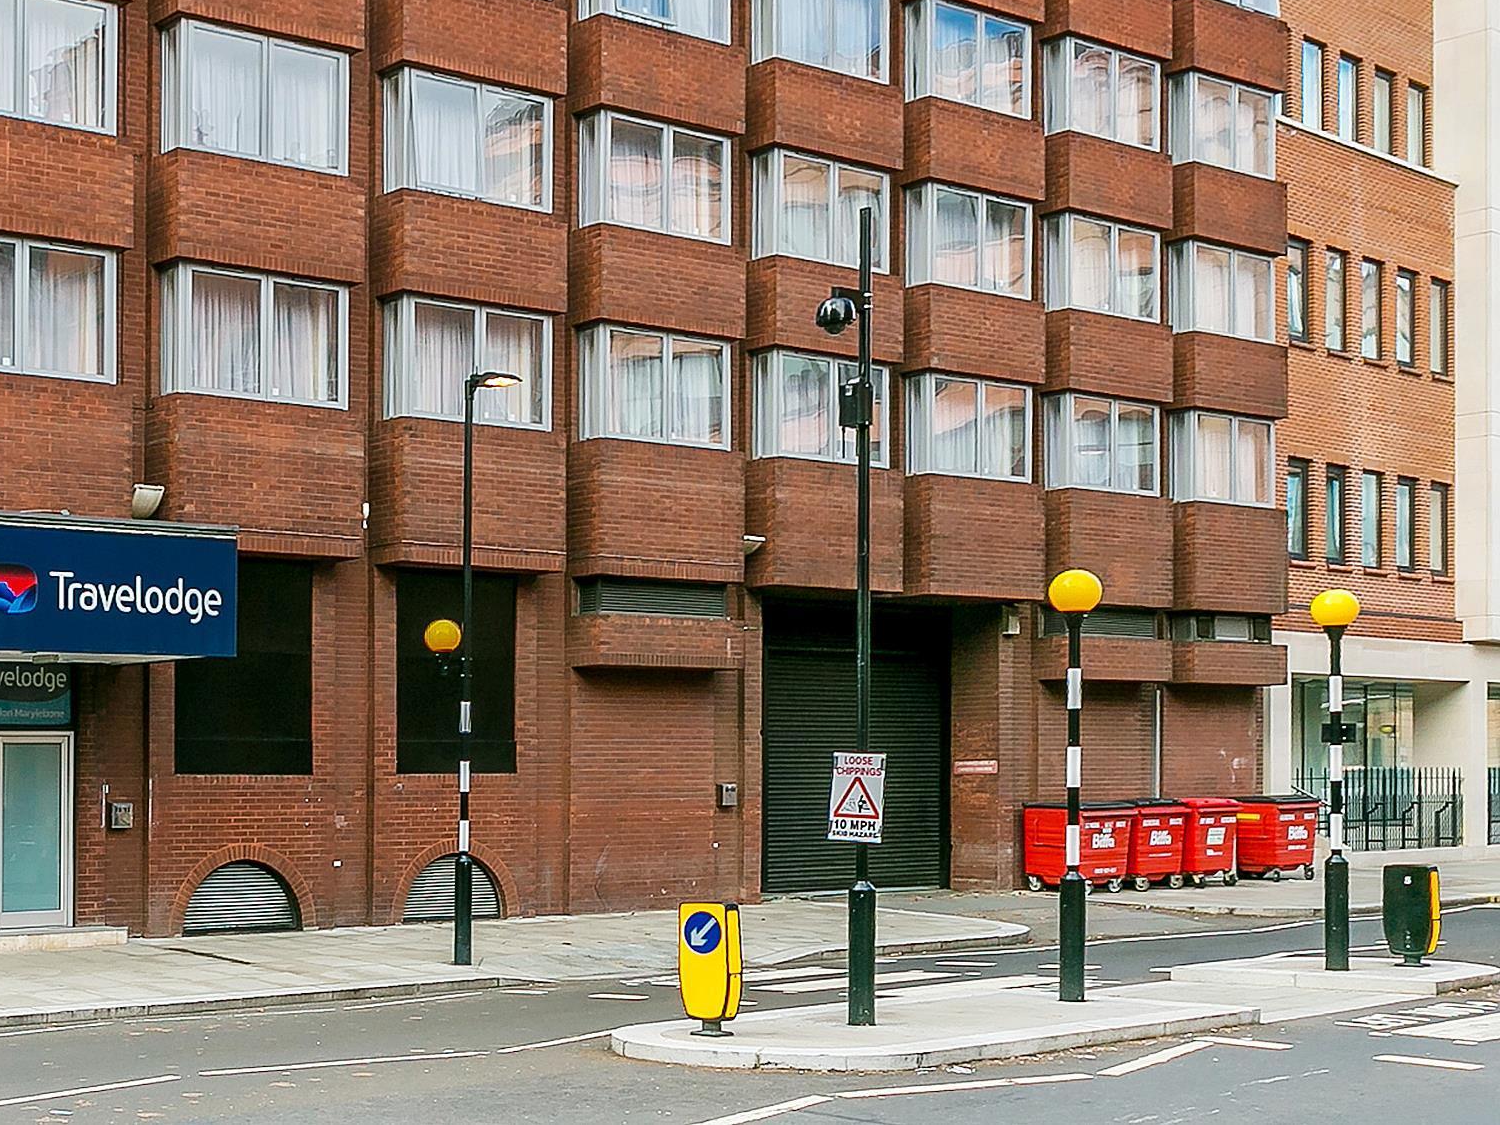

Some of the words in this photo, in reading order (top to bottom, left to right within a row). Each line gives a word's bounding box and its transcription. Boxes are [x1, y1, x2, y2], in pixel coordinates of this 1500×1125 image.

[49, 571, 222, 625] Travelodge
[15, 708, 65, 720] Marylebone
[844, 756, 874, 766] LOOSE
[836, 765, 882, 776] CHIPPINGS
[834, 819, 847, 830] 10
[850, 820, 876, 831] MPH
